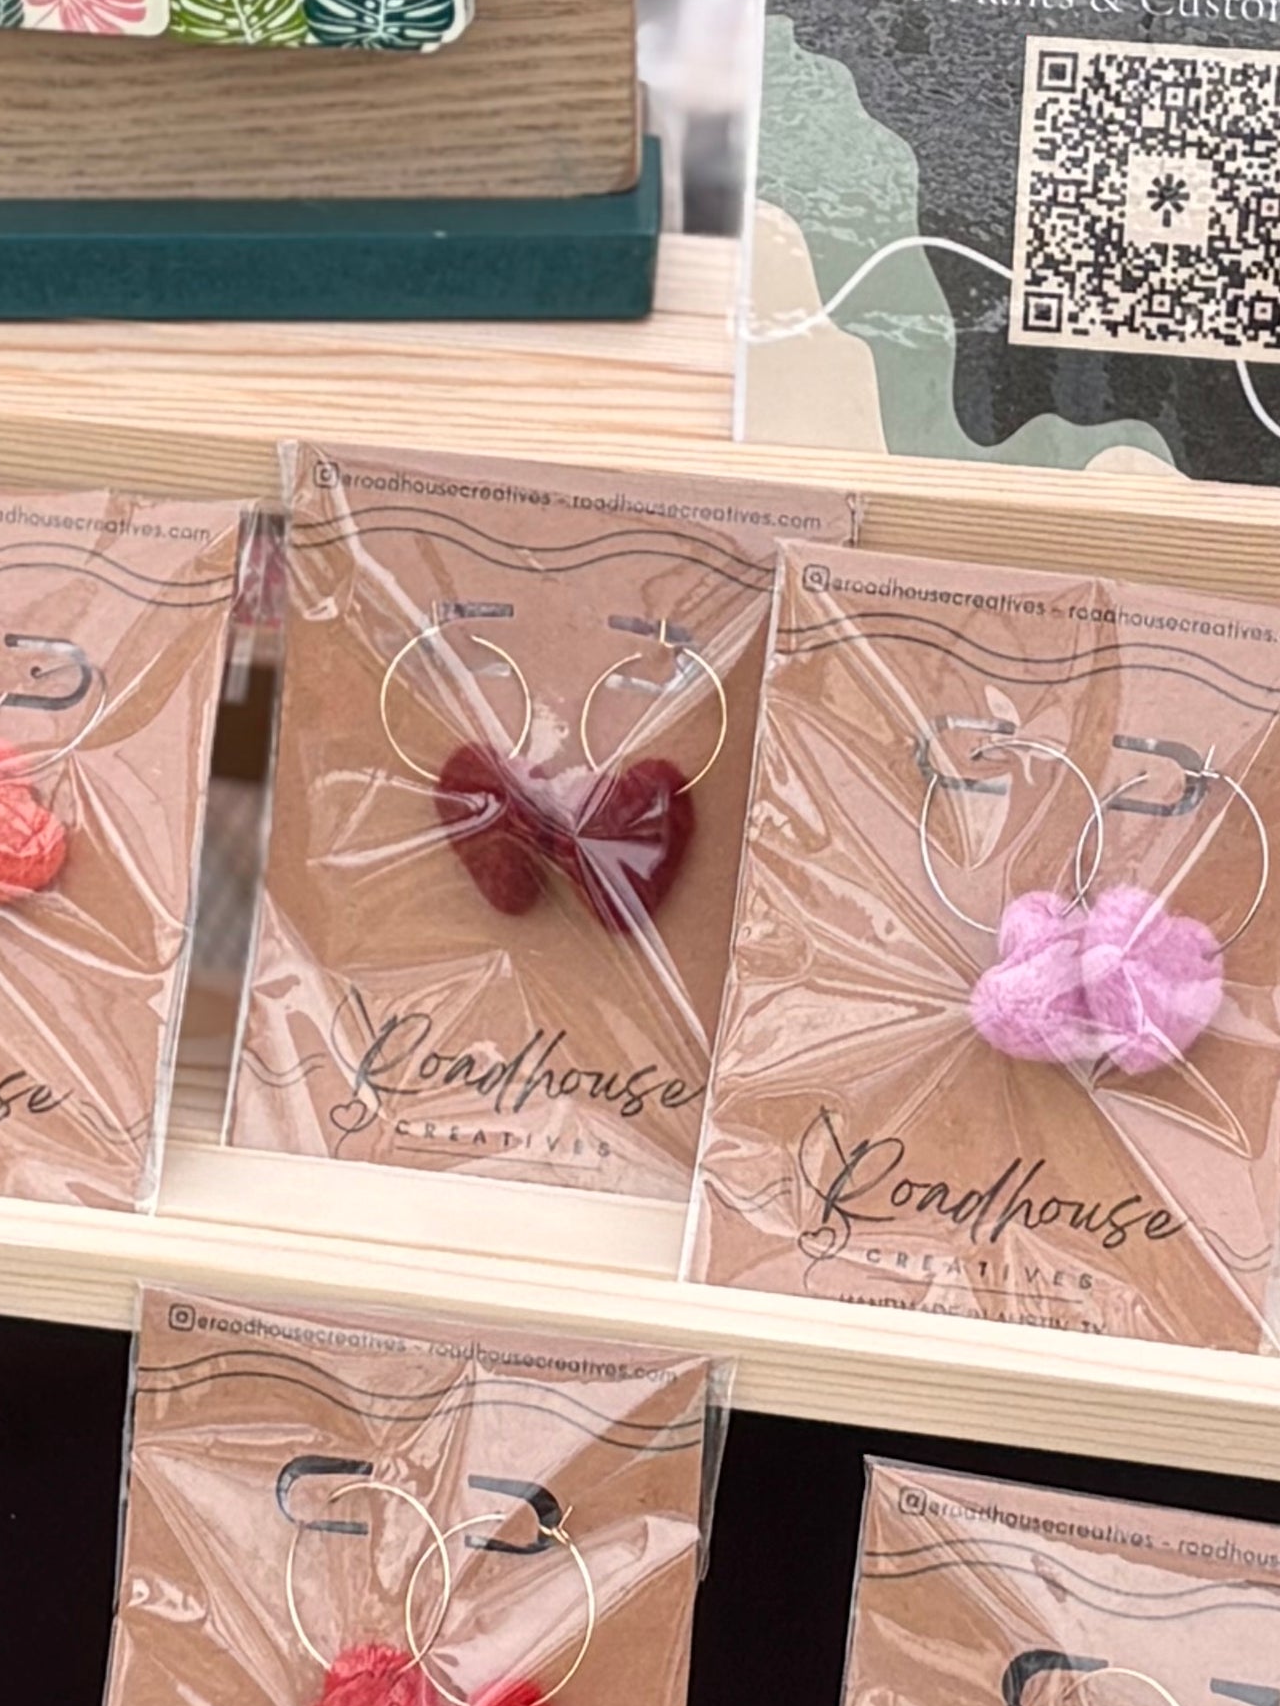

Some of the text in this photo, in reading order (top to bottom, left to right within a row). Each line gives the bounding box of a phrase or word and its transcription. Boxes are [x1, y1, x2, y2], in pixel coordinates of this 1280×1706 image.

[350, 1011, 707, 1118] Roadhouse
[394, 1119, 613, 1159] CREATIVES
[819, 1136, 1190, 1250] Roadhouse
[864, 1246, 1096, 1290] CREATIVES
